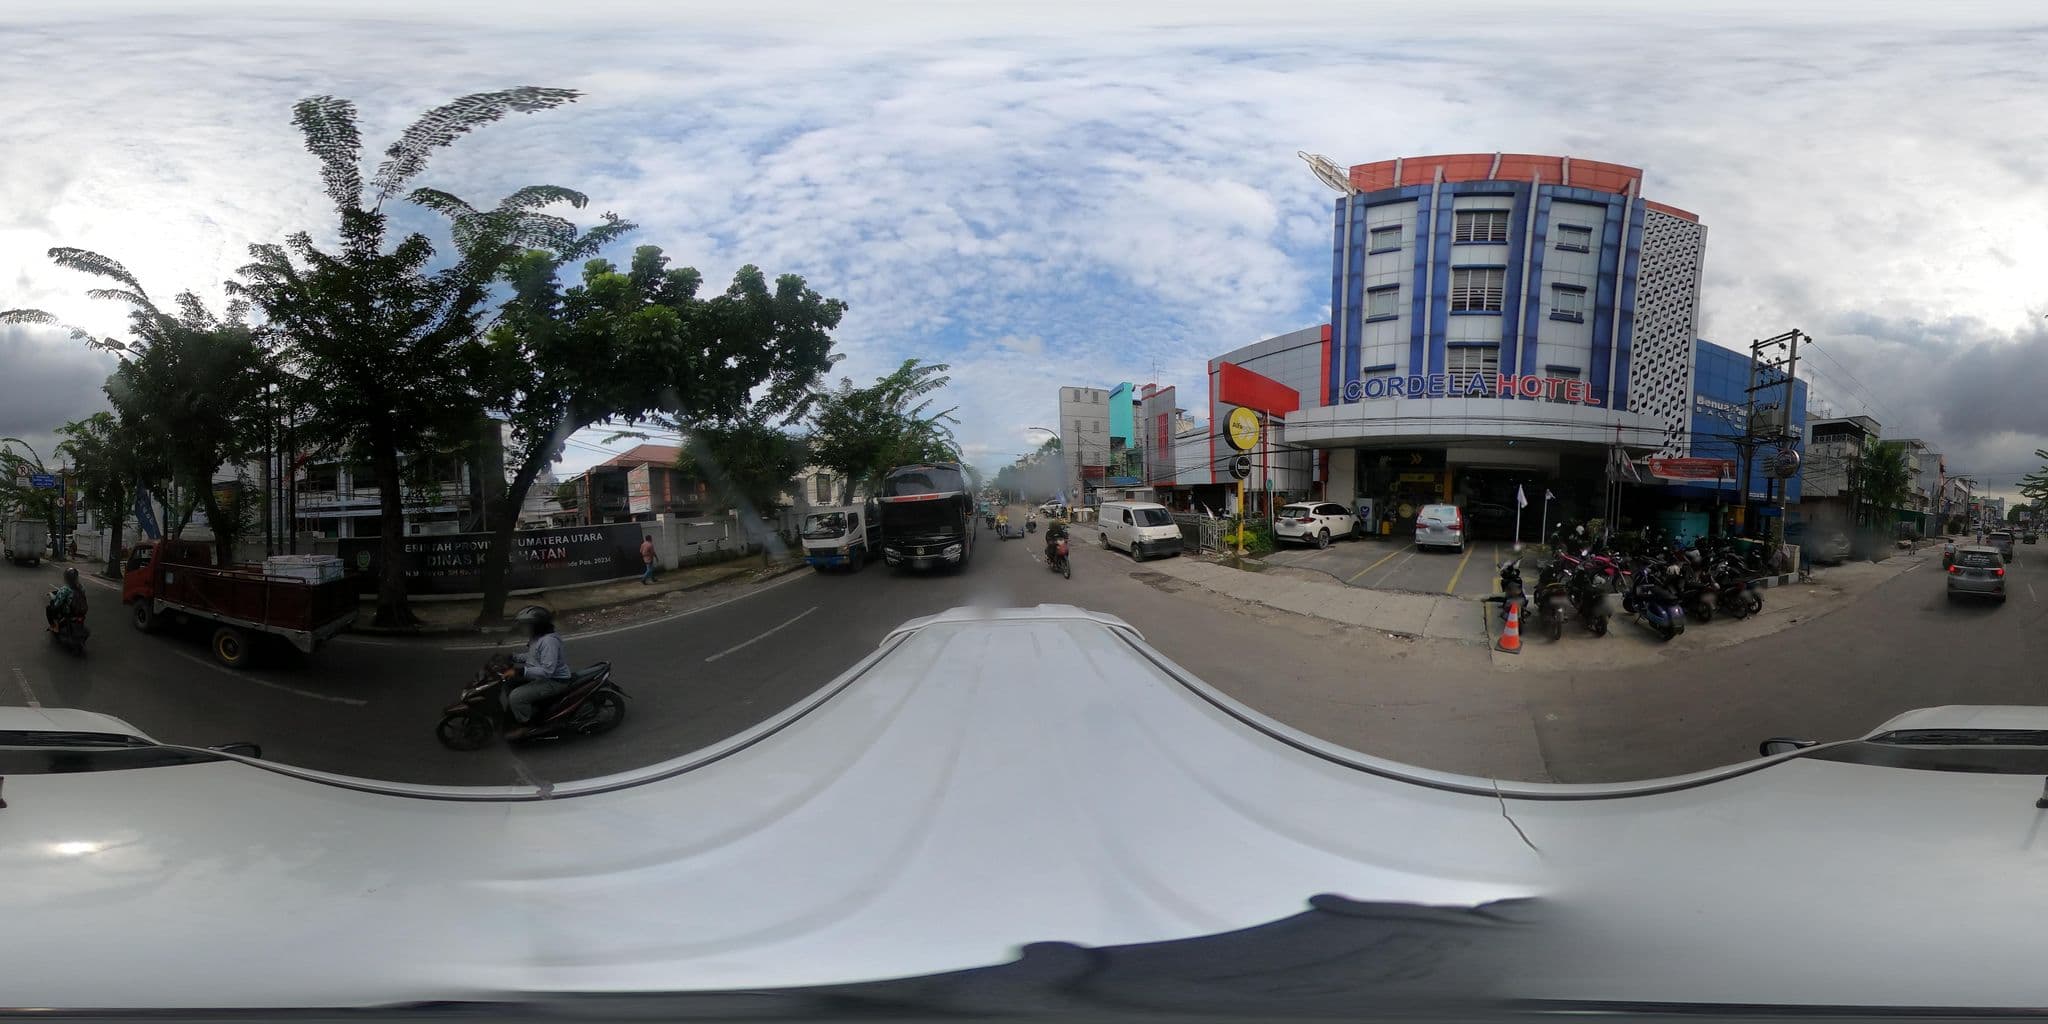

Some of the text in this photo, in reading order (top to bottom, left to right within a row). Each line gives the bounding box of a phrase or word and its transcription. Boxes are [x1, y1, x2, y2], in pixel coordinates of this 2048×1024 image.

[1343, 373, 1601, 404] CORDELA HOTEL
[1696, 395, 1730, 412] Benua
[571, 532, 603, 544] UTARA
